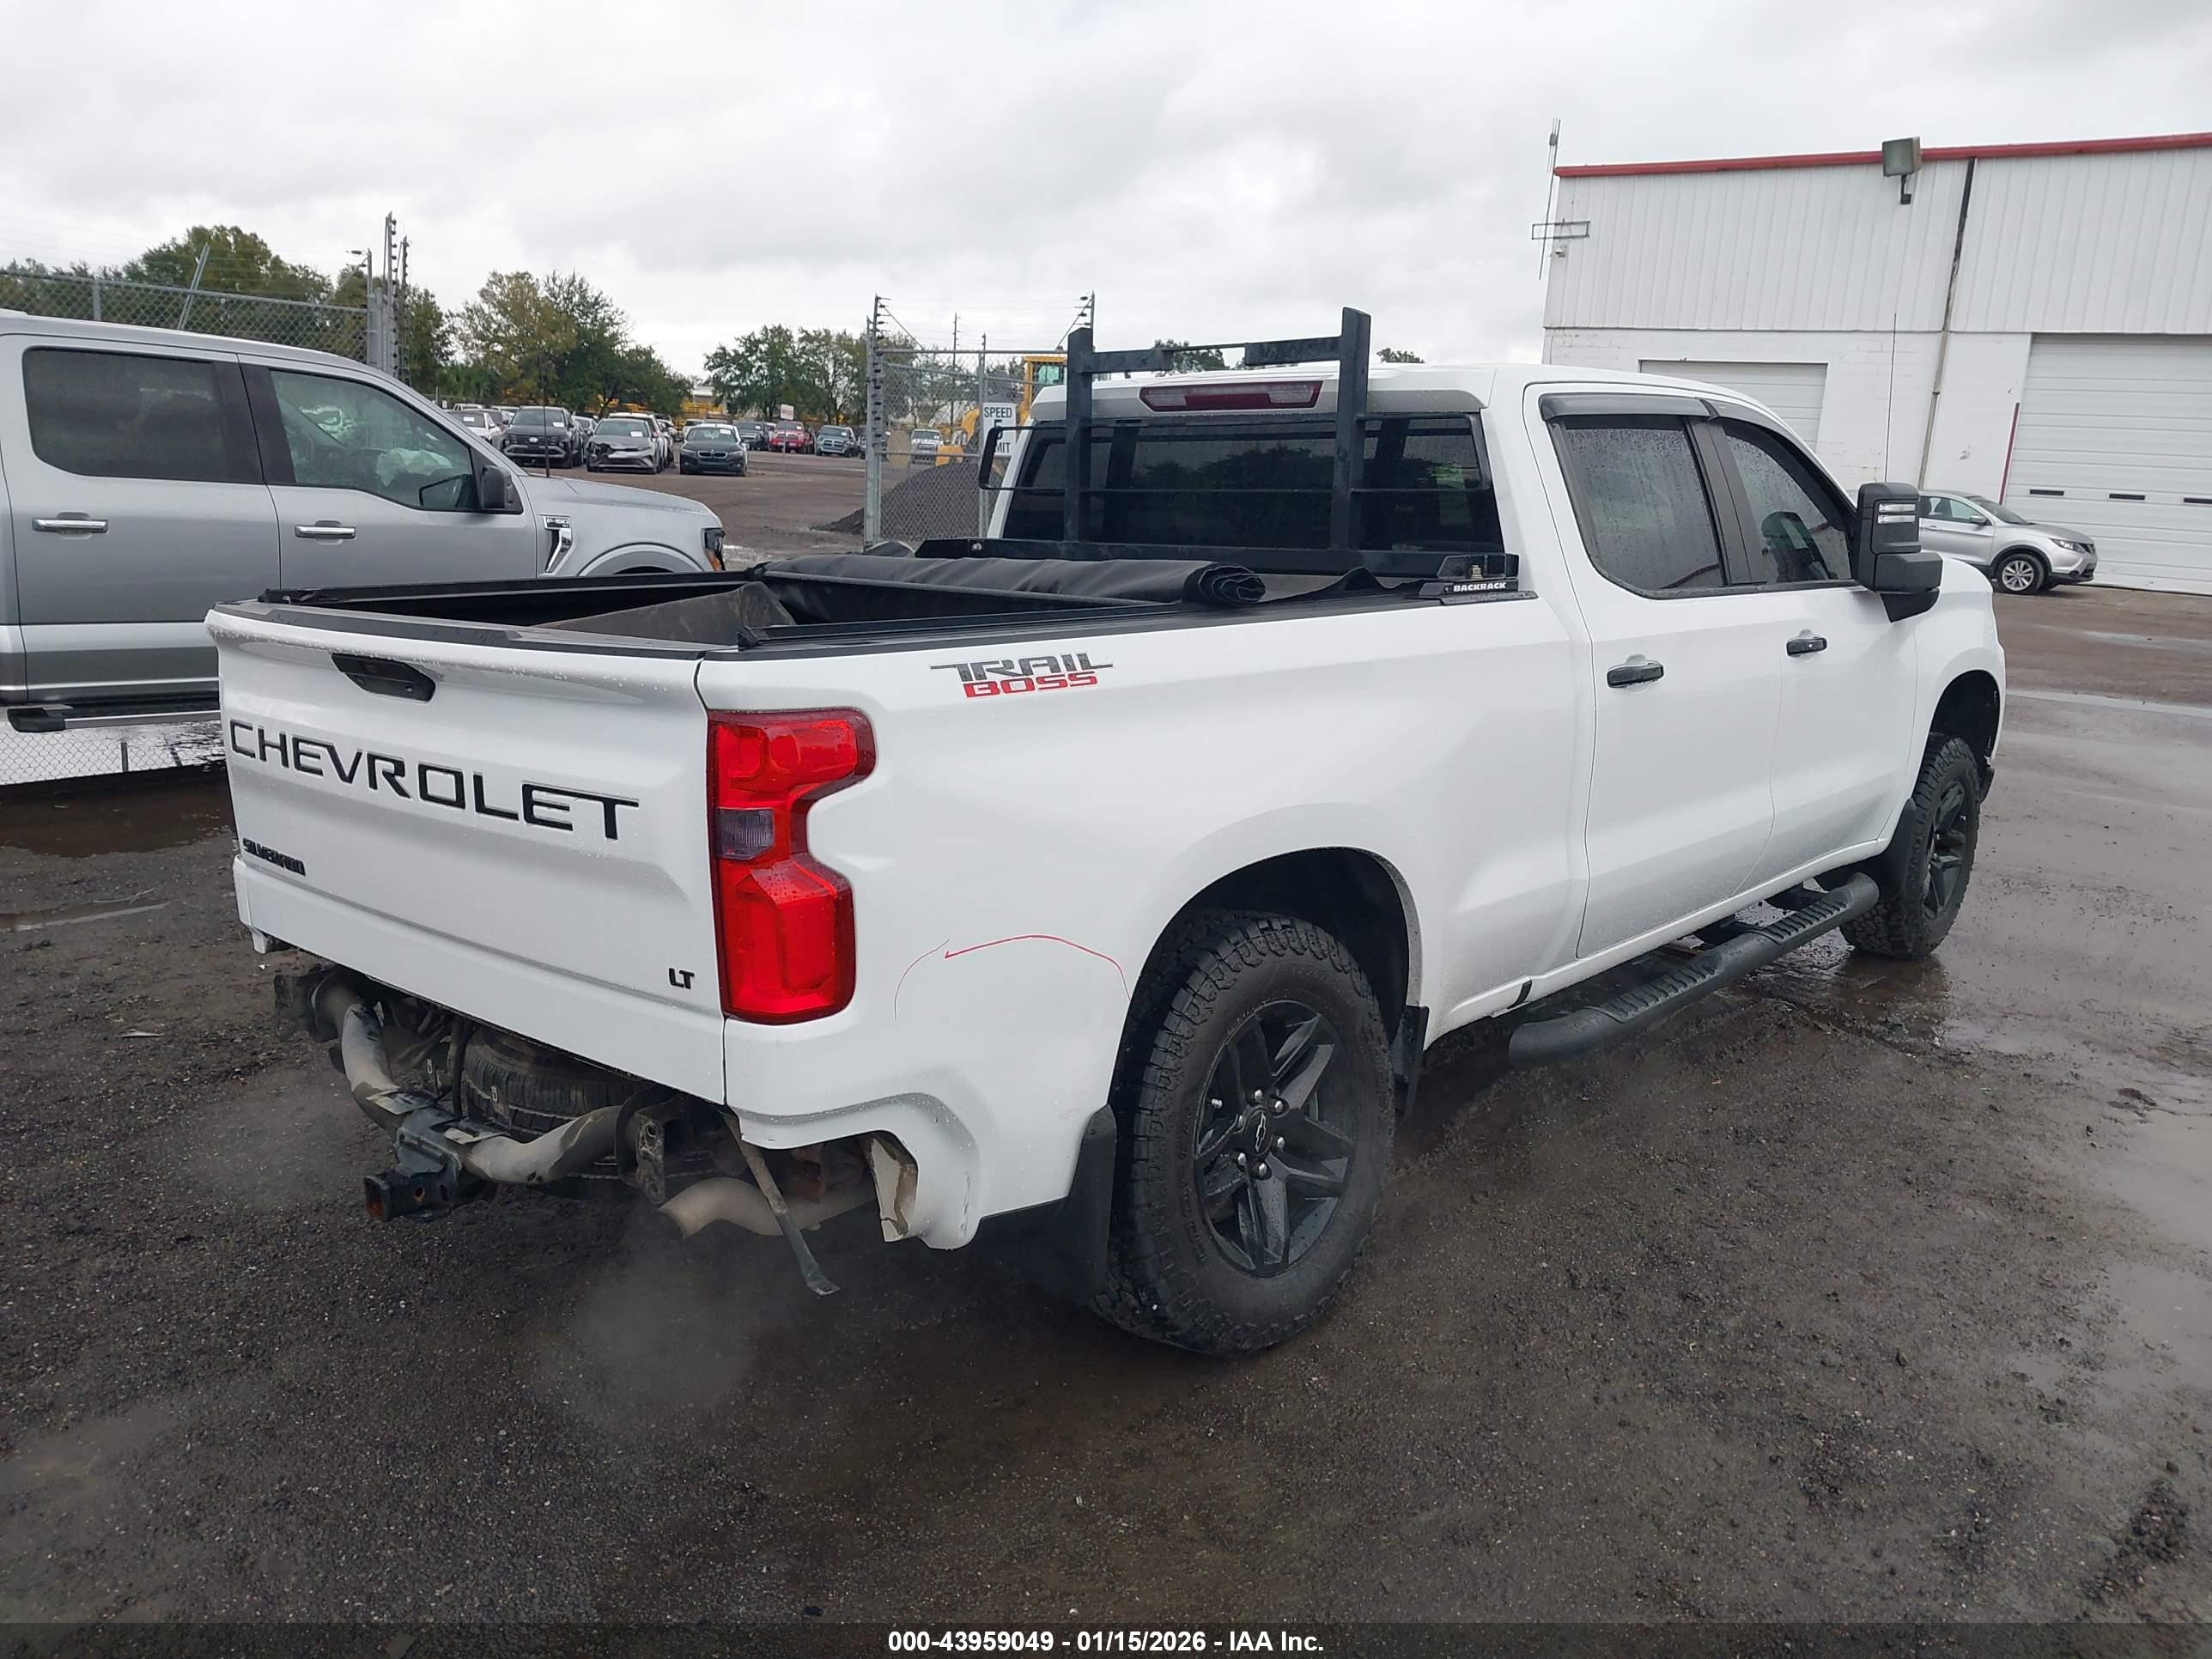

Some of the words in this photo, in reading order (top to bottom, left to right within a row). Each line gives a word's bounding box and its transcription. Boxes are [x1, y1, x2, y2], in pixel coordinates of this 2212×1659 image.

[984, 406, 1012, 418] SPEED
[1453, 582, 1507, 592] BACKRACK
[930, 653, 1114, 682] TRAIL
[963, 671, 1098, 698] BOSS
[230, 720, 640, 841] CHEVROLET
[668, 967, 695, 990] LT
